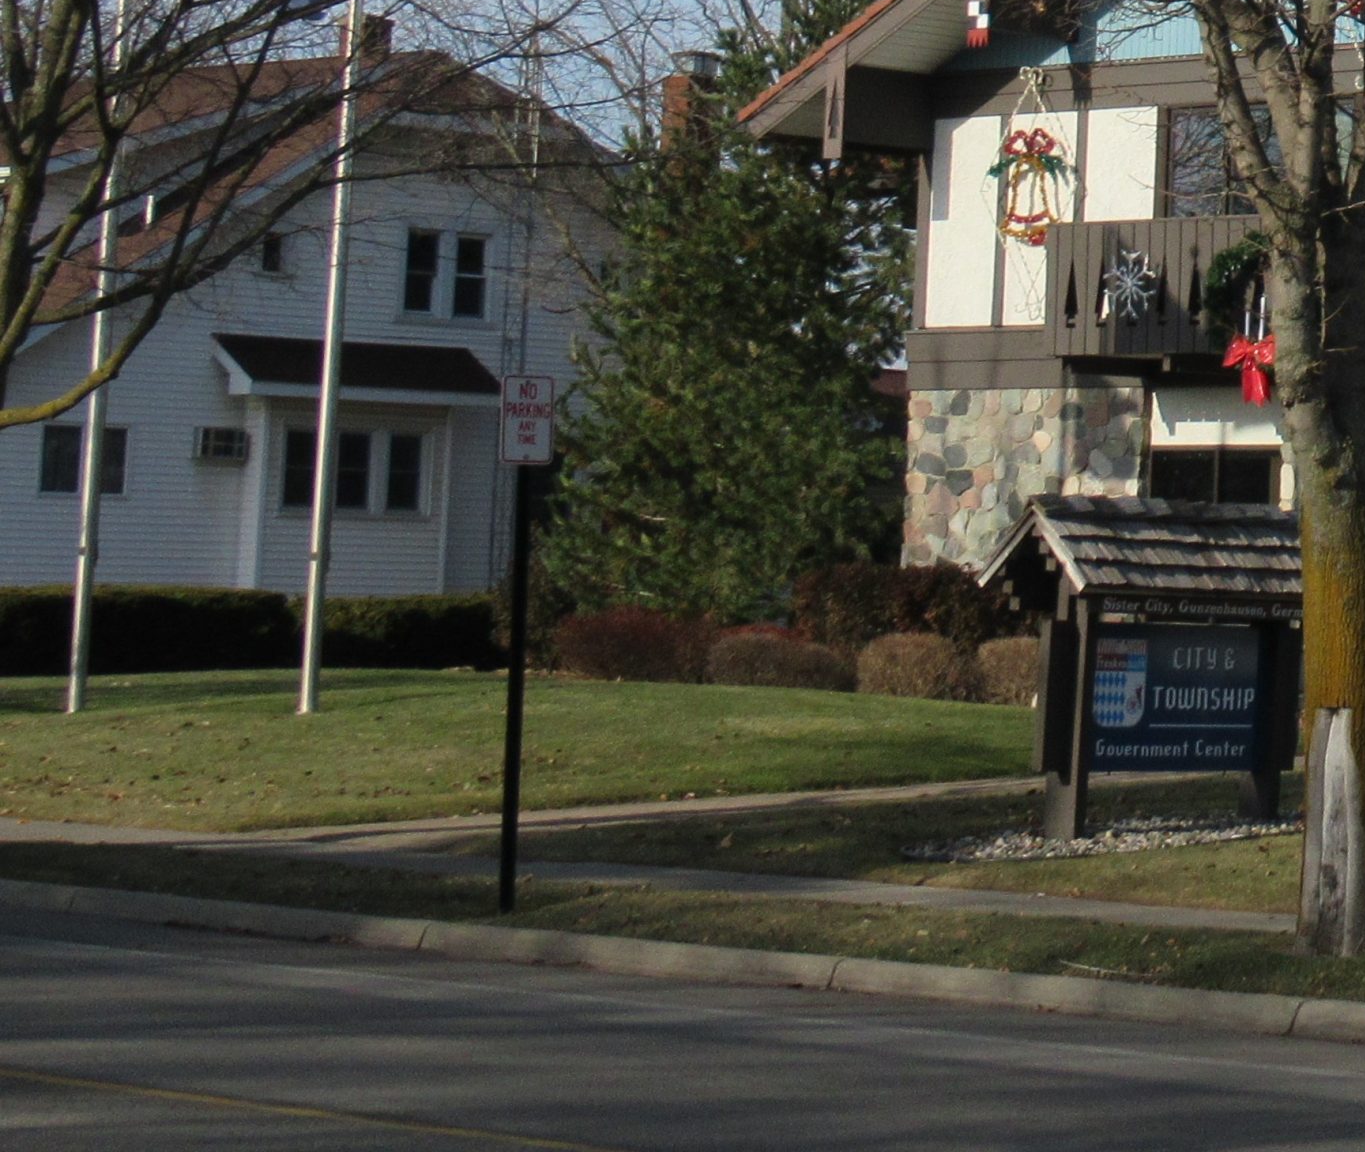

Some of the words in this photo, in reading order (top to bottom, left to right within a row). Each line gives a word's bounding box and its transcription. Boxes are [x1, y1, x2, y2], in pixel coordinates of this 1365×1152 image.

[519, 383, 538, 399] NO
[505, 402, 551, 419] PARKING
[518, 421, 537, 433] ANY
[1103, 596, 1141, 611] Sister
[1271, 603, 1304, 618] Germ
[1173, 647, 1217, 669] CITY
[1224, 647, 1236, 669] &
[1153, 686, 1256, 710] TOWNSHIP
[1095, 738, 1189, 757] Government
[1194, 738, 1246, 757] Center
